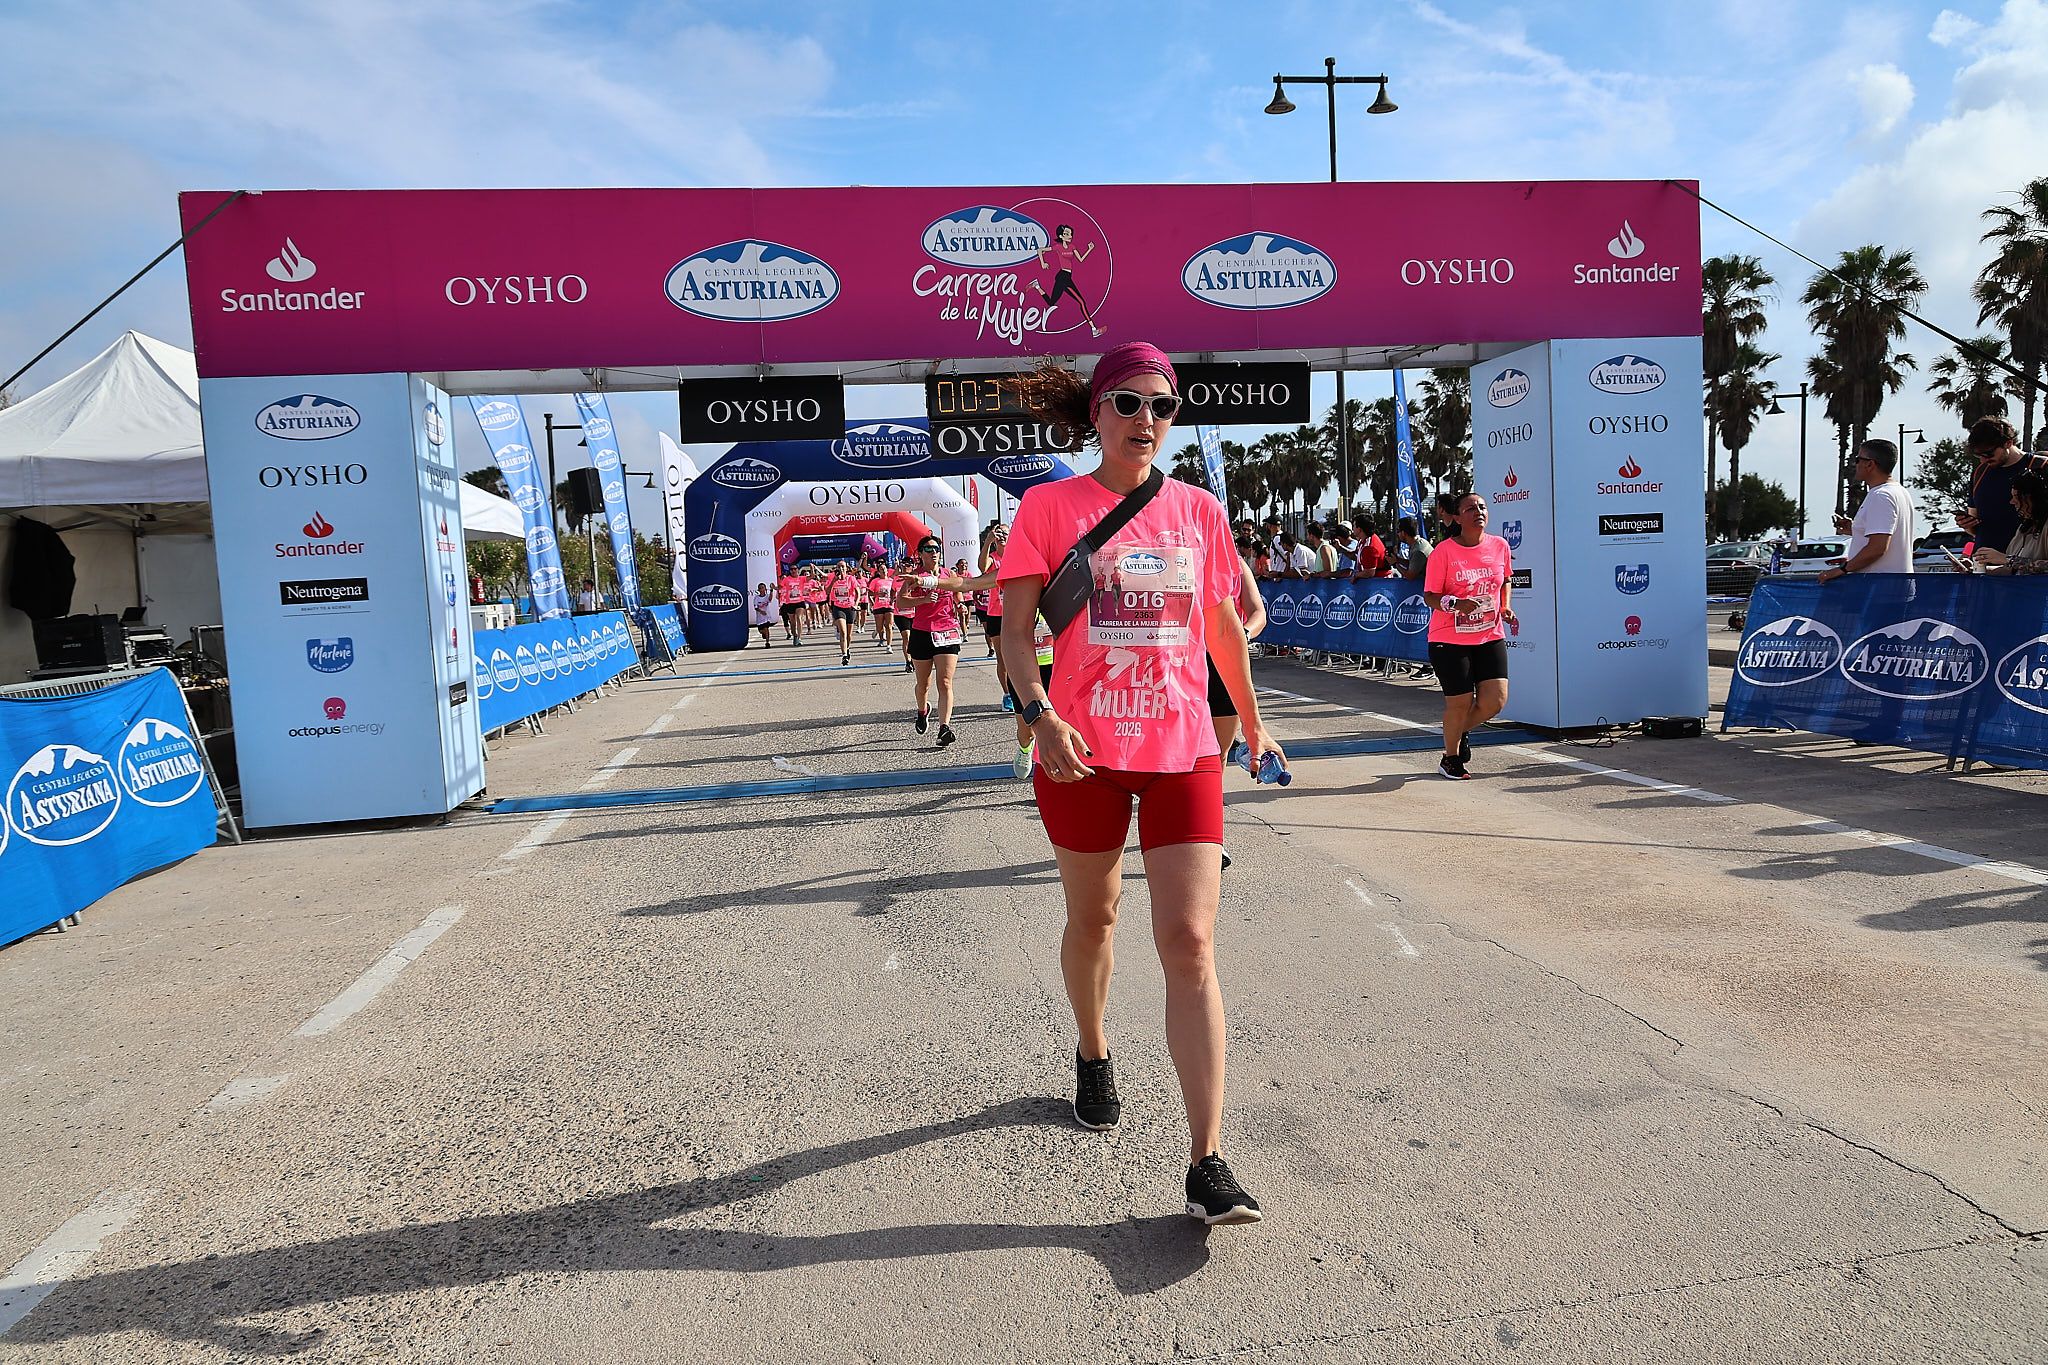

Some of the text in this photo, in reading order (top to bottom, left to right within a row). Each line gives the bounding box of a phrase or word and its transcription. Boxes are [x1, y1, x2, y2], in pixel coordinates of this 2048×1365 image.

[932, 229, 1039, 253] ASTURIANA
[704, 266, 821, 277] CENTRAL LECHERA
[1218, 259, 1266, 267] CENTRAL
[1194, 262, 1325, 290] ASTURIANA
[1401, 258, 1514, 286] OYSHO
[1574, 262, 1680, 284] Santander
[680, 269, 828, 301] ASTURIANA
[912, 265, 1019, 297] Carrera
[444, 274, 589, 306] OYSHO
[221, 286, 365, 312] Santander
[940, 292, 1058, 345] de la Mujer
[1595, 370, 1660, 385] ASTURIANA
[1188, 383, 1291, 406] OYSHO
[1490, 383, 1527, 402] ASTURIANA
[707, 398, 821, 425] OYSHO
[264, 412, 354, 430] ASTURIANA
[1588, 414, 1669, 435] OYSHO
[1488, 422, 1533, 448] OYSHO
[840, 438, 930, 457] ASTURIANA
[259, 463, 368, 488] OYSHO
[716, 469, 775, 482] ASTURIANA
[994, 461, 1051, 474] ASTURIANA
[809, 483, 906, 506] OYSHO
[1597, 480, 1663, 494] Santander
[932, 501, 961, 509] OYSHO
[1493, 489, 1530, 504] Santander
[752, 510, 782, 518] OYSHO
[800, 512, 884, 525] Sports Santander
[1604, 517, 1660, 532] Neutrogena
[275, 541, 365, 557] Santander
[692, 545, 739, 556] ASTURIANA
[746, 550, 770, 558] YSHO
[1123, 561, 1164, 570] ASTURIANA
[1455, 568, 1494, 582] CARRERA
[1617, 571, 1648, 587] Marlene
[286, 584, 364, 600] Neutrogena
[1124, 591, 1165, 608] 016
[693, 596, 740, 606] ASTURIANA
[1134, 611, 1154, 619] 2363
[1100, 632, 1134, 640] OYSHO
[1597, 637, 1669, 650] octopus energy
[1759, 640, 1793, 648] CENTRAL
[310, 645, 351, 664] Marlene
[1741, 642, 1827, 669] ASTURIANA
[1879, 643, 1975, 658] CENTRAL LECHERA
[1131, 655, 1154, 688] LA
[1849, 643, 1974, 683] ASTURIANA
[1090, 687, 1168, 720] MUJER
[288, 722, 385, 738] octopus energy
[1114, 721, 1142, 737] 2026
[126, 753, 201, 793] ASTURIANA
[32, 776, 72, 795] CENTRAL
[20, 778, 117, 832] ASTURIANA
